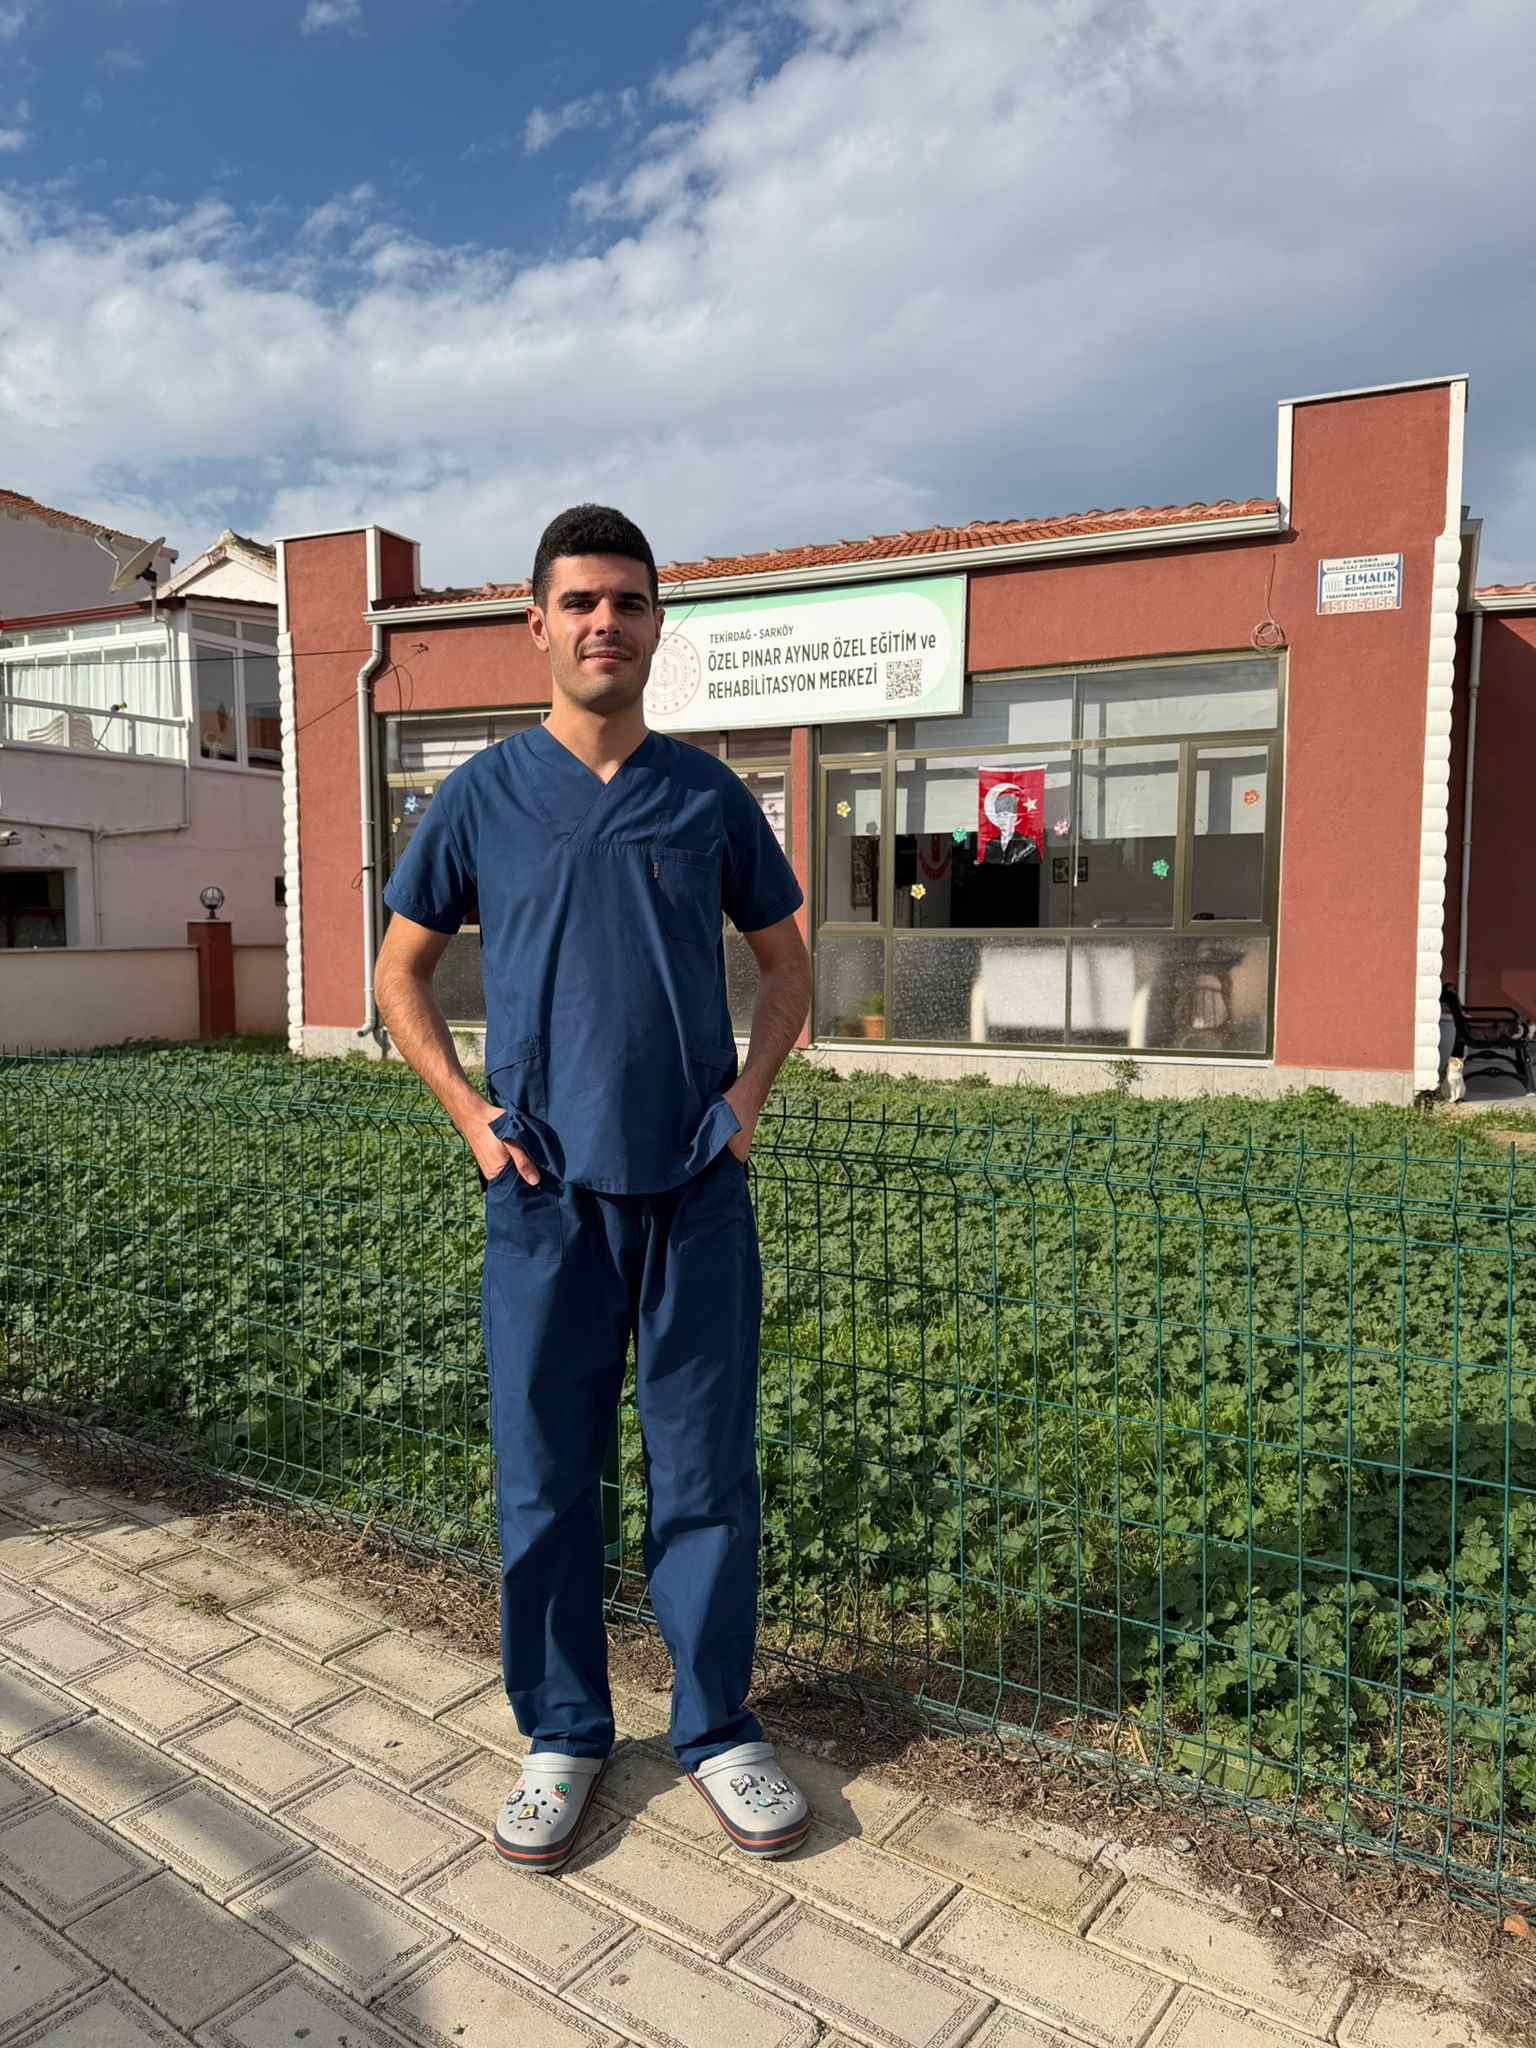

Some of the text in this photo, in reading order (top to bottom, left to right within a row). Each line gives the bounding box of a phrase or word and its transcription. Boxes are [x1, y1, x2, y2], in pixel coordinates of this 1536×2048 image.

[1345, 571, 1396, 585] ELMALIK
[709, 628, 752, 644] TEKİRDAĞ
[759, 624, 794, 641] ŞARKÖY
[708, 651, 739, 671] ÖZEL
[742, 648, 782, 669] PINAR
[785, 643, 829, 665] AYNUR
[833, 636, 866, 659] ÖZEL
[870, 630, 917, 655] EĞİTİM
[920, 632, 936, 649] ve
[708, 662, 878, 700] REHABİLİTASYON MERKEZİ
